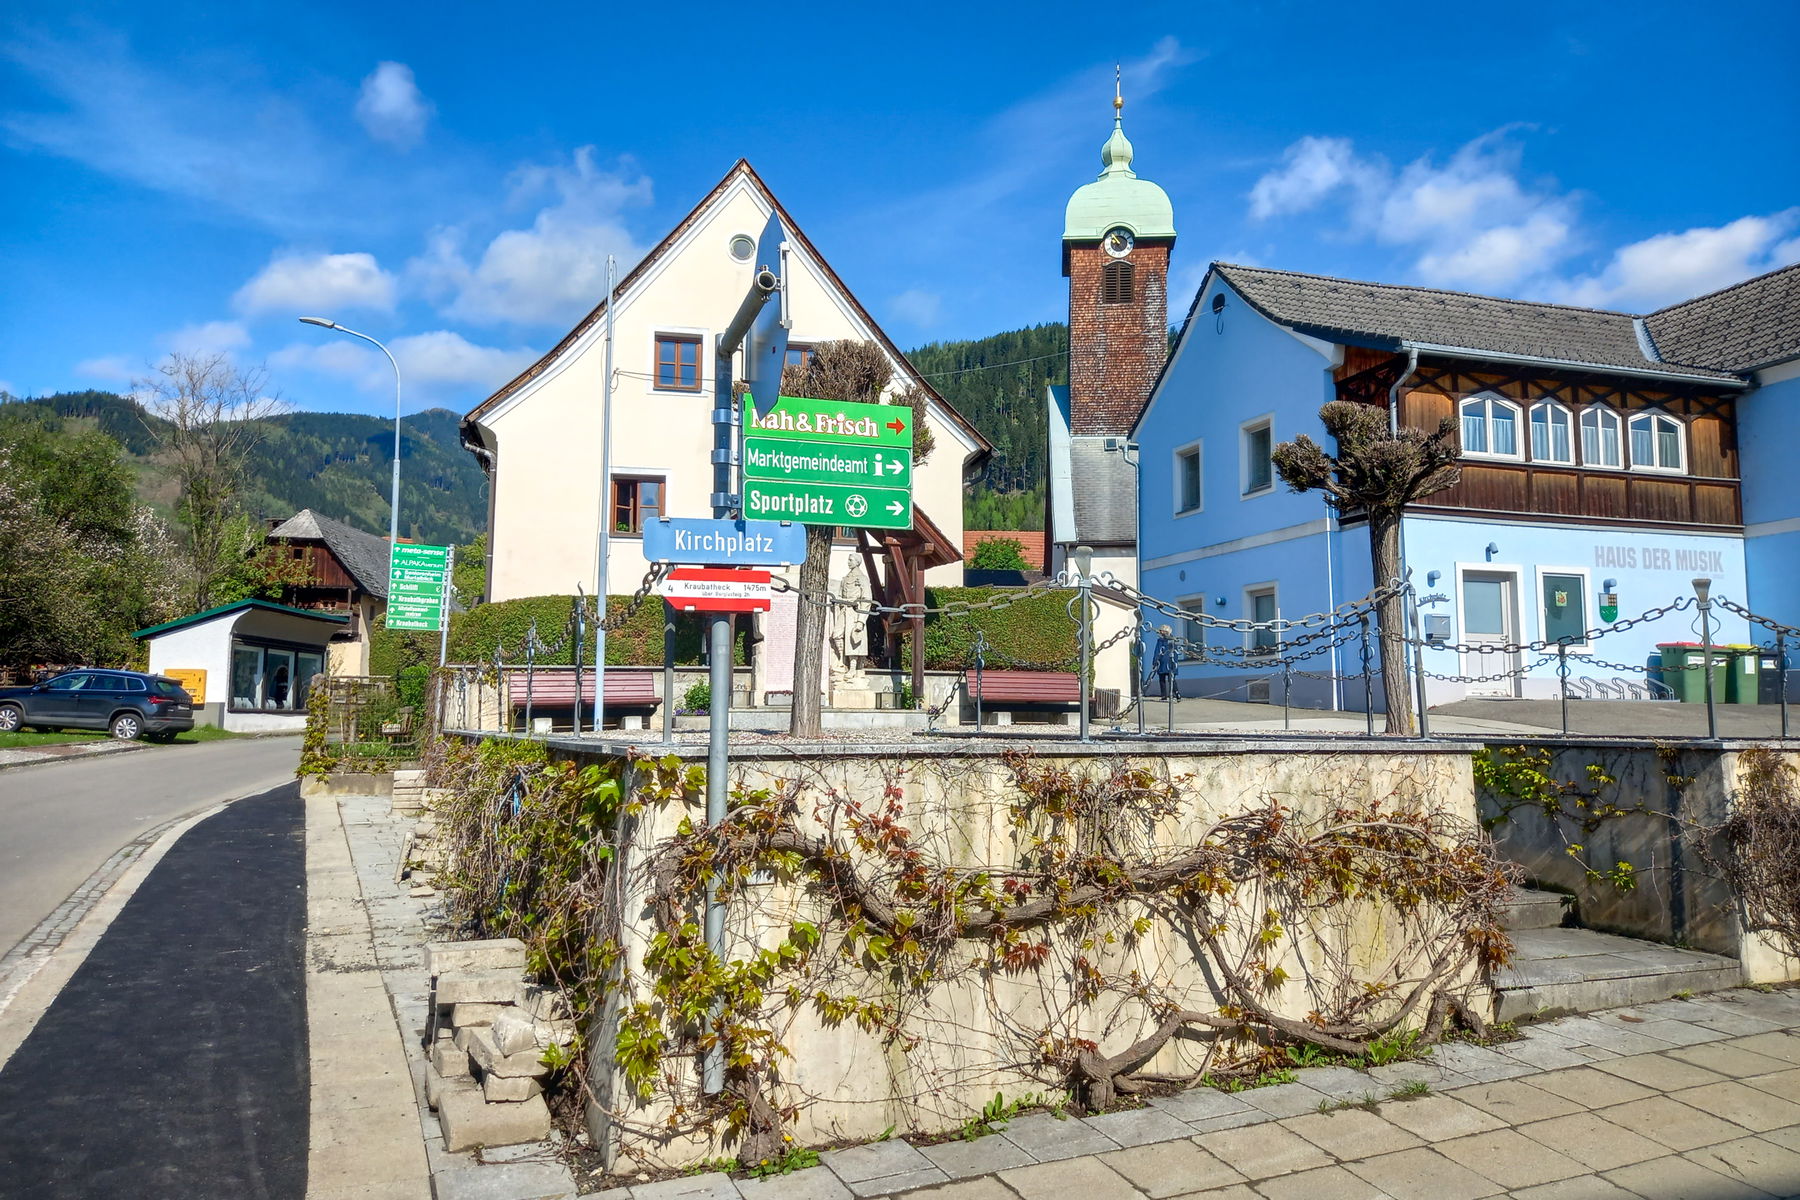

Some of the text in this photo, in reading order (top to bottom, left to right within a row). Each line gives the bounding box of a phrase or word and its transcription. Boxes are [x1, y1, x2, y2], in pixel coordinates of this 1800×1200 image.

[747, 448, 868, 474] Marktgemeindeamt
[750, 490, 834, 516] Sportplatz
[675, 530, 773, 556] Kirchplatz
[1594, 545, 1724, 573] HAUS DER MUSIK
[667, 582, 767, 593] 4 Kraubatheck 1475m
